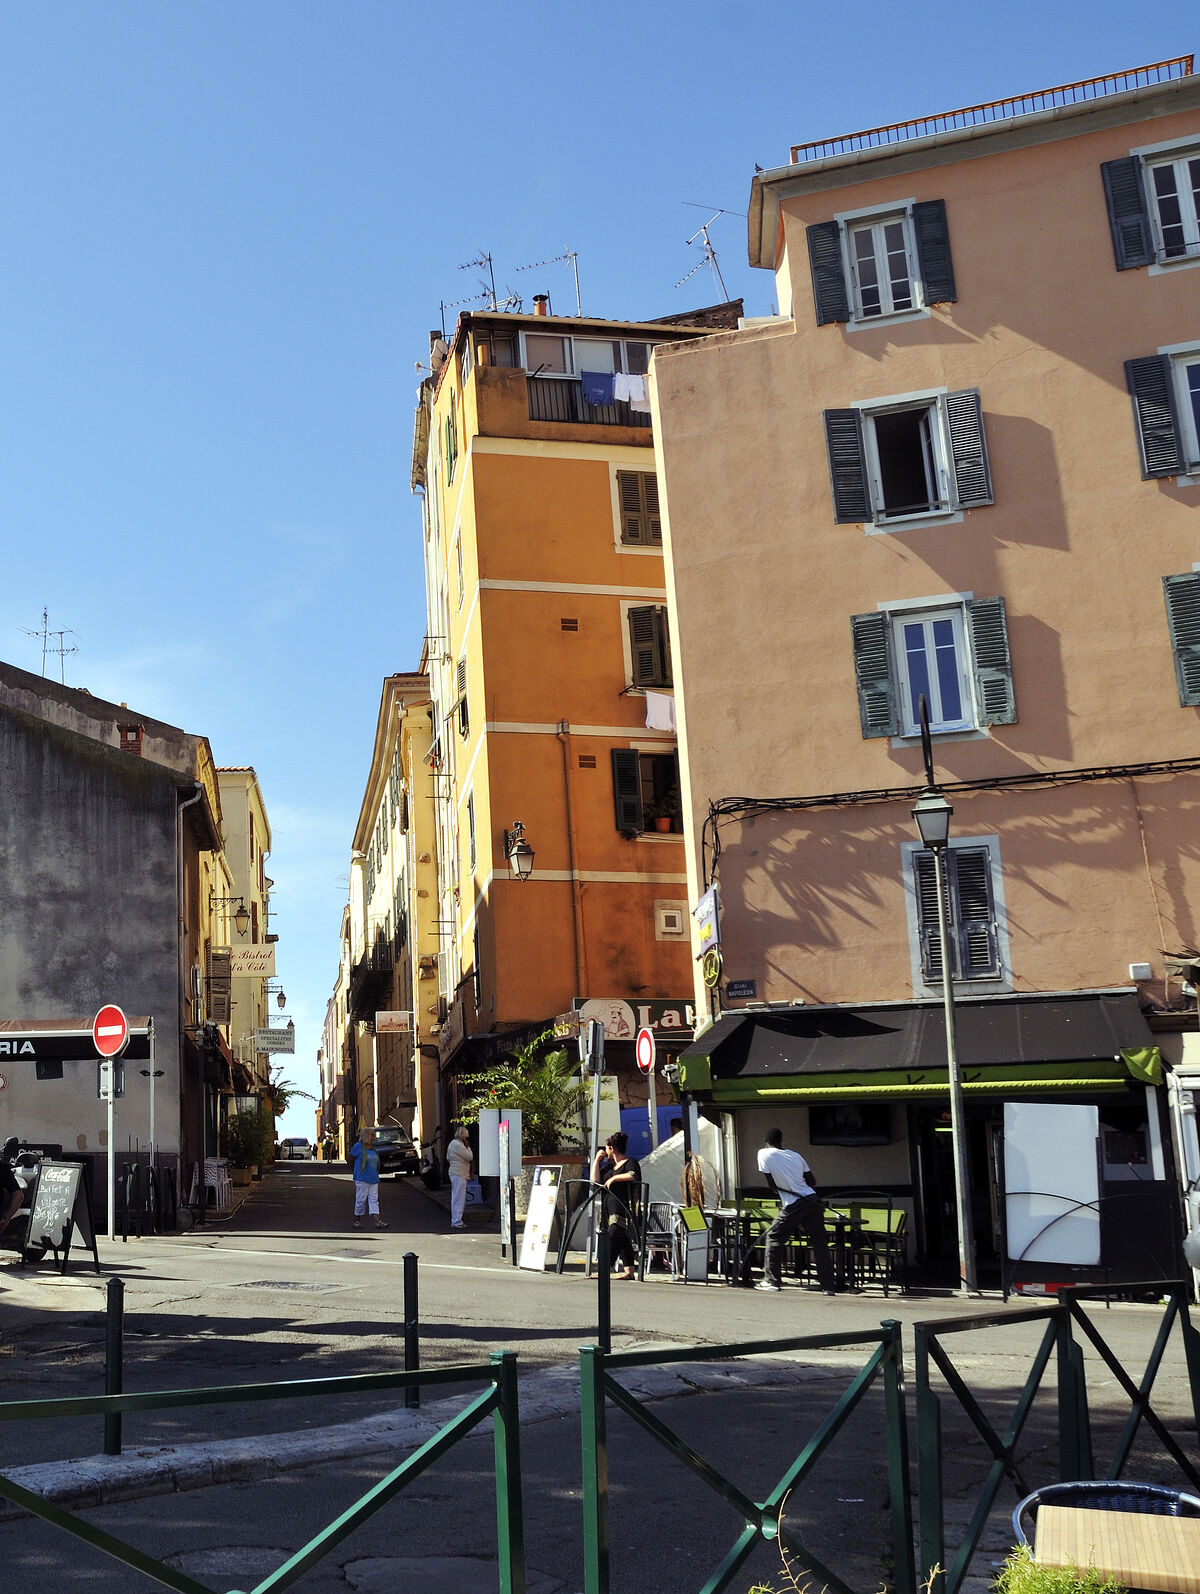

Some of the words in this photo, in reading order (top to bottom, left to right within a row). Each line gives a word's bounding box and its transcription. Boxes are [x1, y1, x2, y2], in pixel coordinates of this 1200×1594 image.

[239, 950, 273, 960] Bistrot
[246, 961, 268, 971] Côté
[637, 1005, 682, 1029] La
